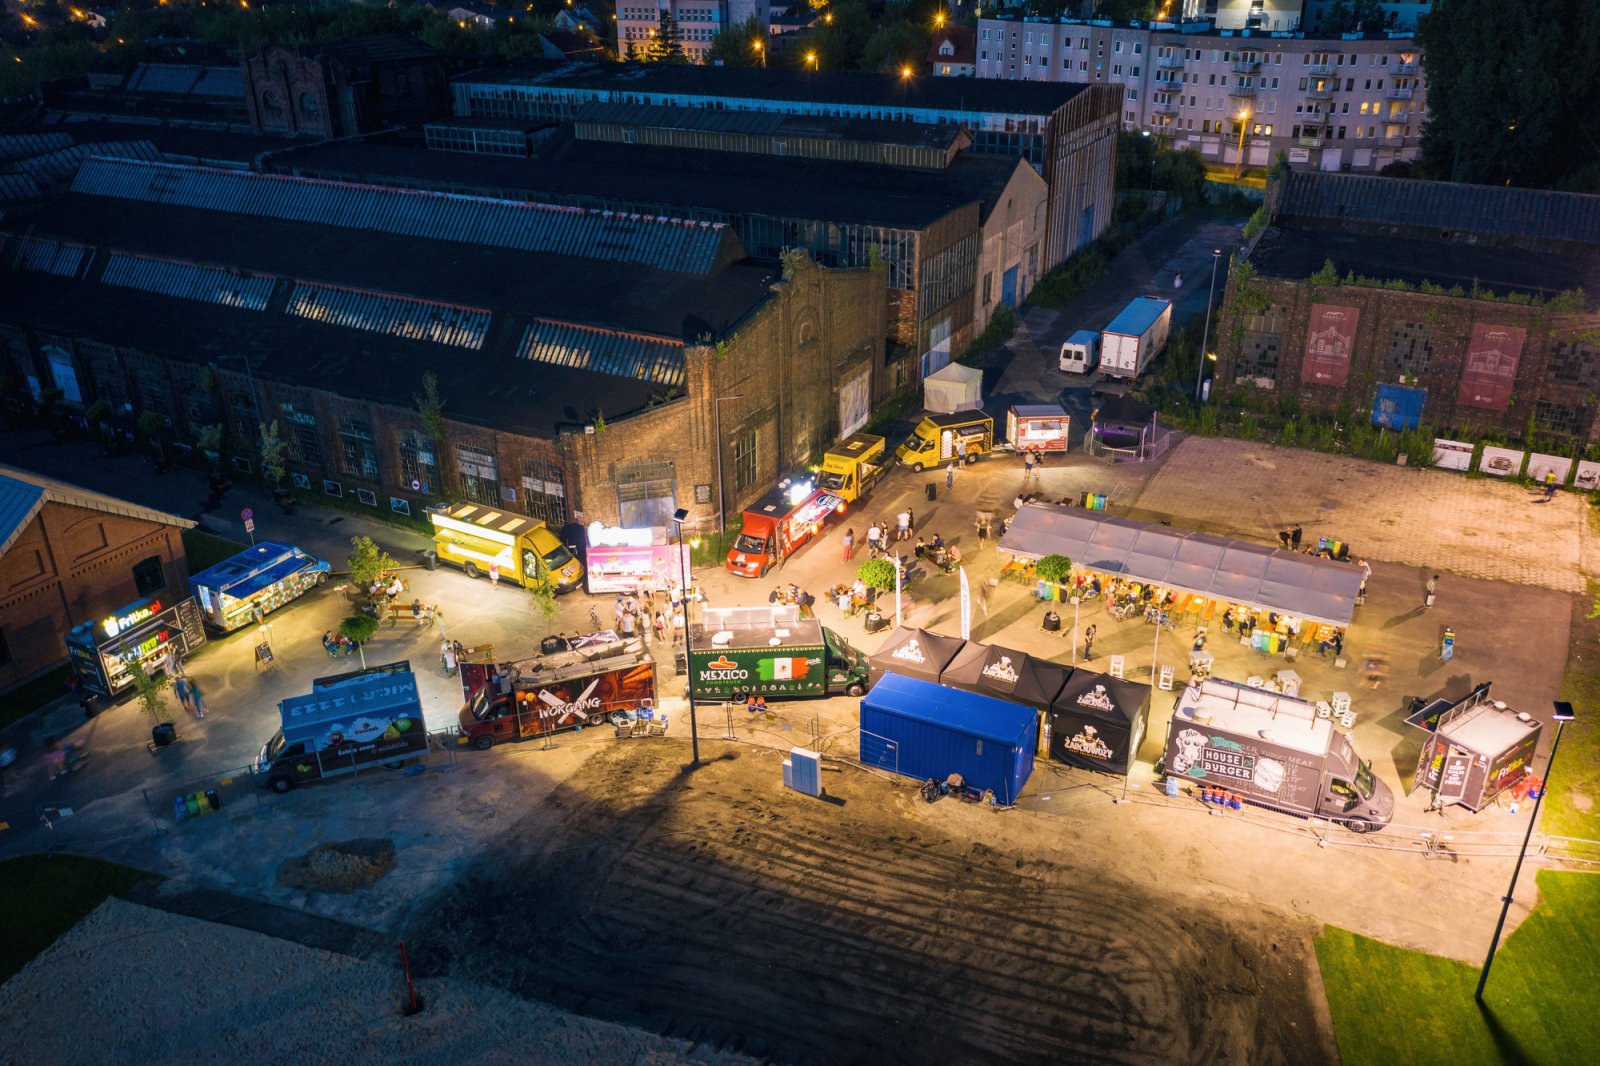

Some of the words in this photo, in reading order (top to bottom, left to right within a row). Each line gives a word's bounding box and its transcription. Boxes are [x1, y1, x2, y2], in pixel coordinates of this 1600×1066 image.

[118, 600, 162, 630] Fritka.pl
[700, 669, 748, 681] MEXICO
[539, 697, 601, 719] WOKGANG
[1064, 735, 1114, 759] ŻARCIOWOZY
[1206, 752, 1240, 765] HOUSE
[1288, 756, 1313, 768] MEAT
[1428, 742, 1446, 781] Fritka.pl
[1204, 762, 1251, 779] BURGER
